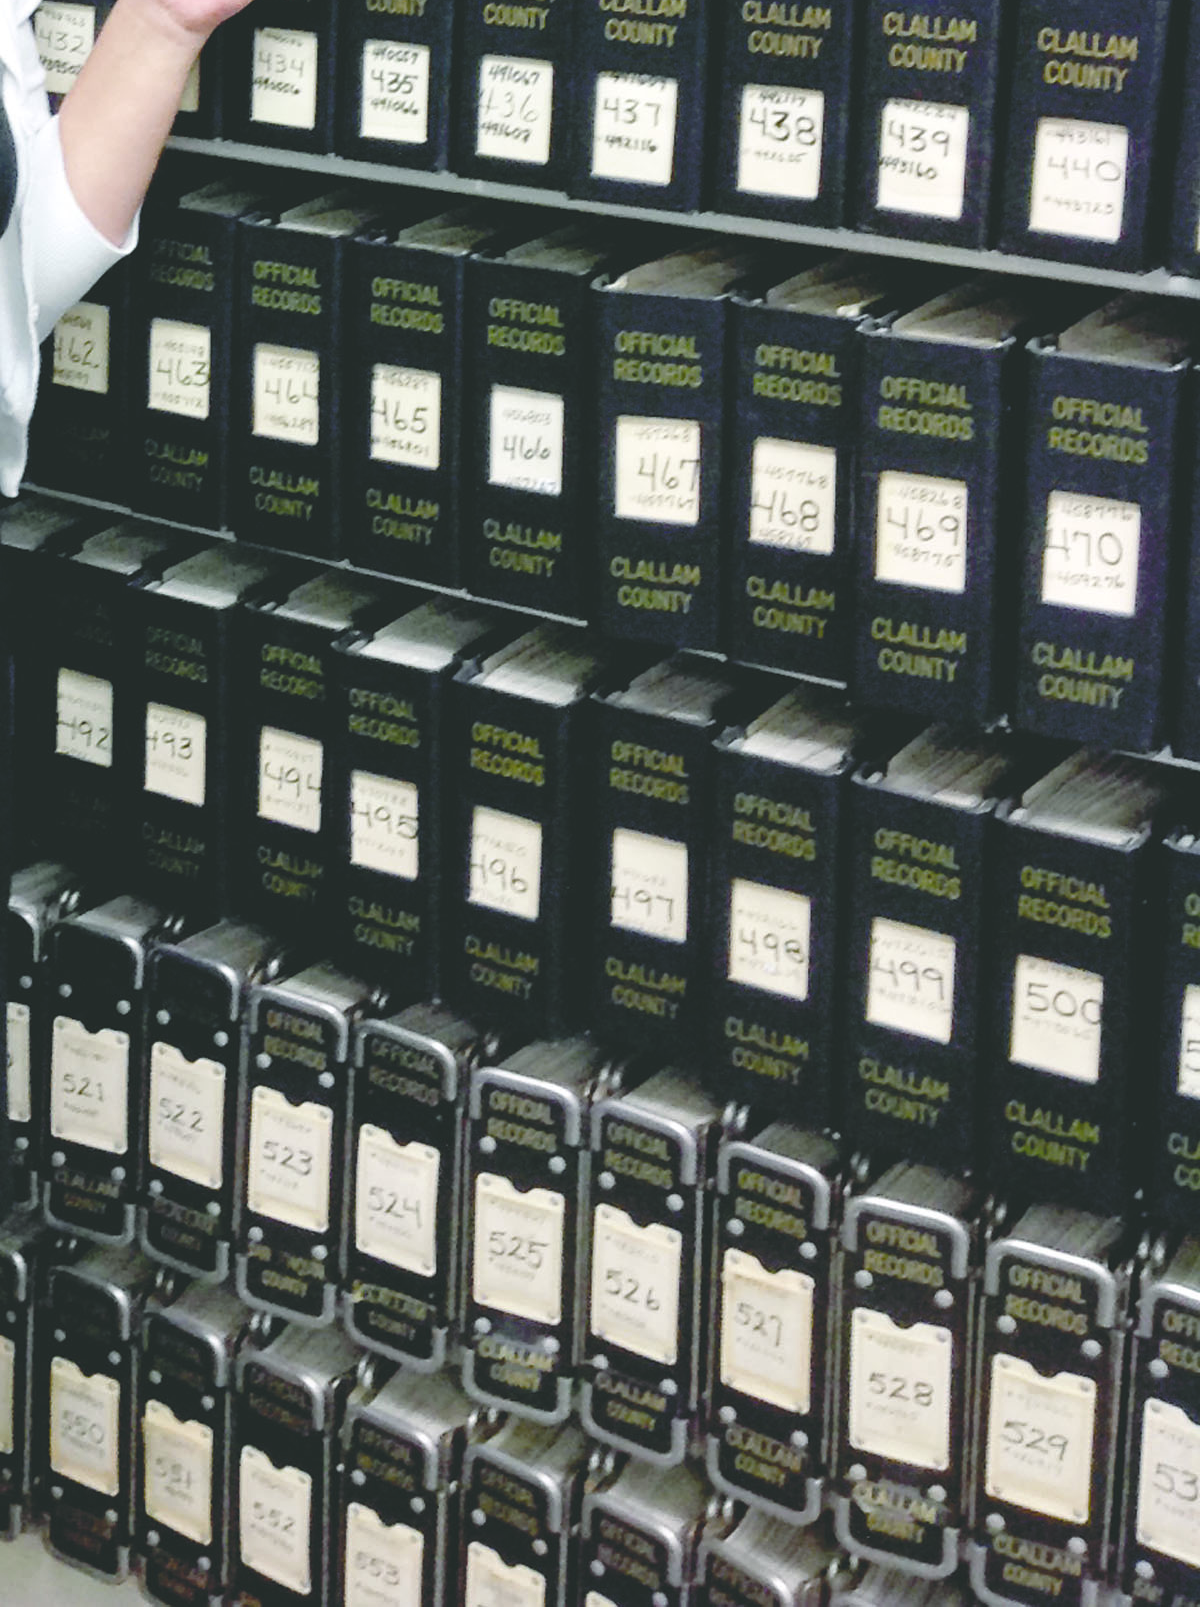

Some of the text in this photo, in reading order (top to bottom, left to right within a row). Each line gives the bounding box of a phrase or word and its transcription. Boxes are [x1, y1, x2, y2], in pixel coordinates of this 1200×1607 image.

[1036, 28, 1137, 61] CLALLAM
[369, 67, 418, 96] 435
[1042, 61, 1129, 92] COUNTY
[603, 96, 662, 128] 437
[748, 106, 816, 149] 438
[503, 432, 551, 462] 466
[637, 451, 701, 493] 467
[750, 491, 820, 532] 468
[886, 510, 961, 547] 469
[1045, 528, 1123, 568] 470
[611, 885, 673, 921] 497
[872, 958, 945, 999] 499
[62, 1071, 108, 1101] 521
[262, 1141, 312, 1178] 523
[367, 1186, 423, 1226] 524
[487, 1231, 546, 1270] 525
[605, 1266, 664, 1311] 526
[735, 1303, 782, 1342] 527
[869, 1372, 933, 1404] 528
